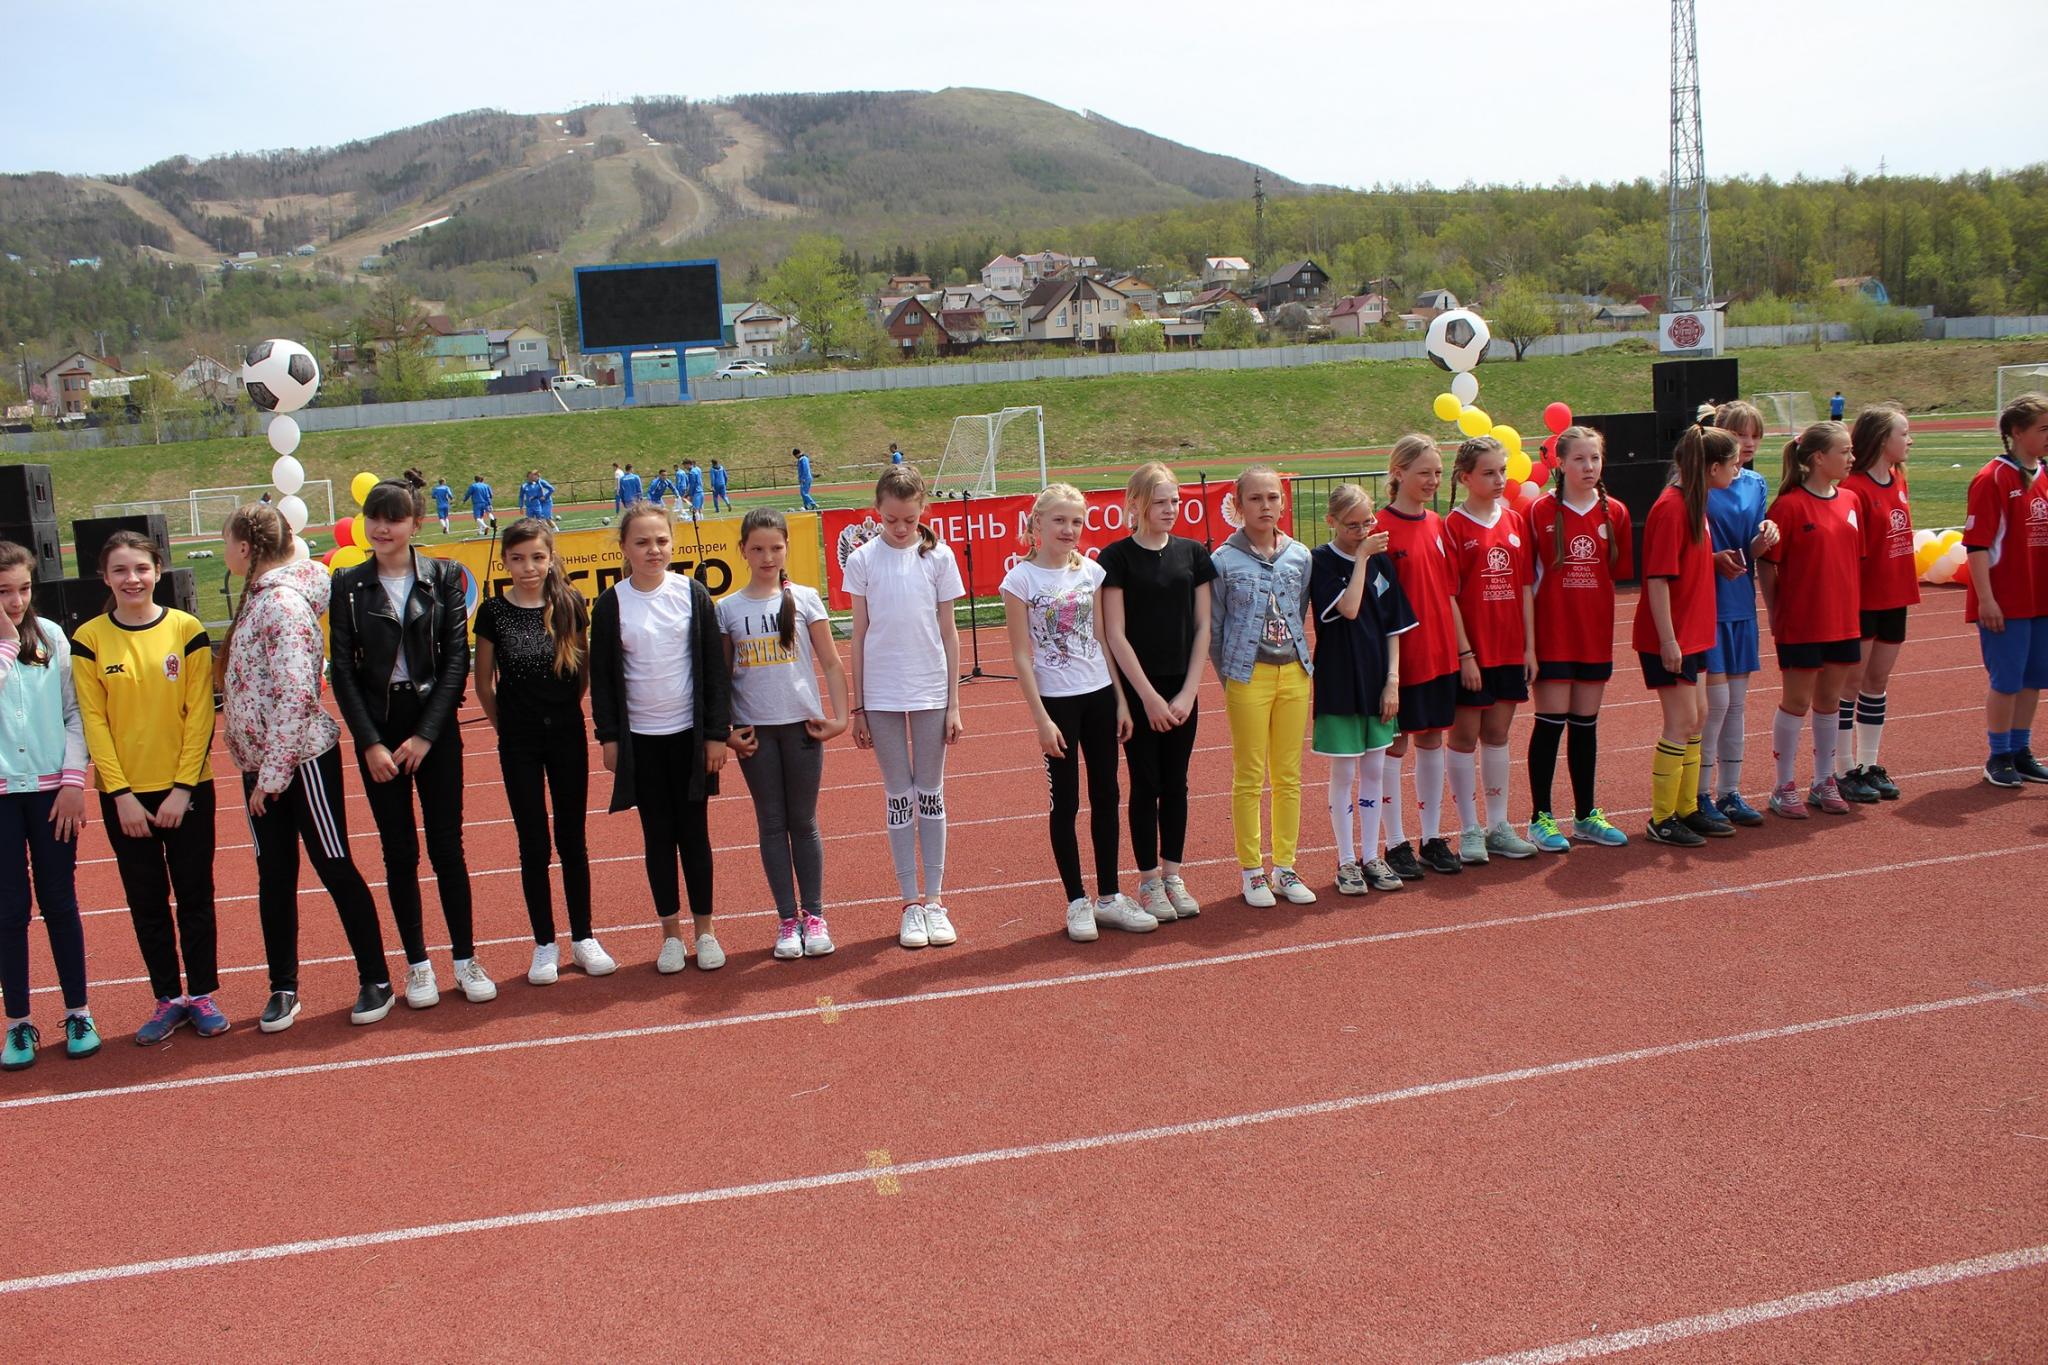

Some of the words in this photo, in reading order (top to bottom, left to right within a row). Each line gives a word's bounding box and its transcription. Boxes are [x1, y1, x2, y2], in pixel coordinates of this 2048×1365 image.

[929, 513, 1006, 545] ДЕНЬ
[678, 543, 727, 555] лотереи
[744, 616, 751, 635] I
